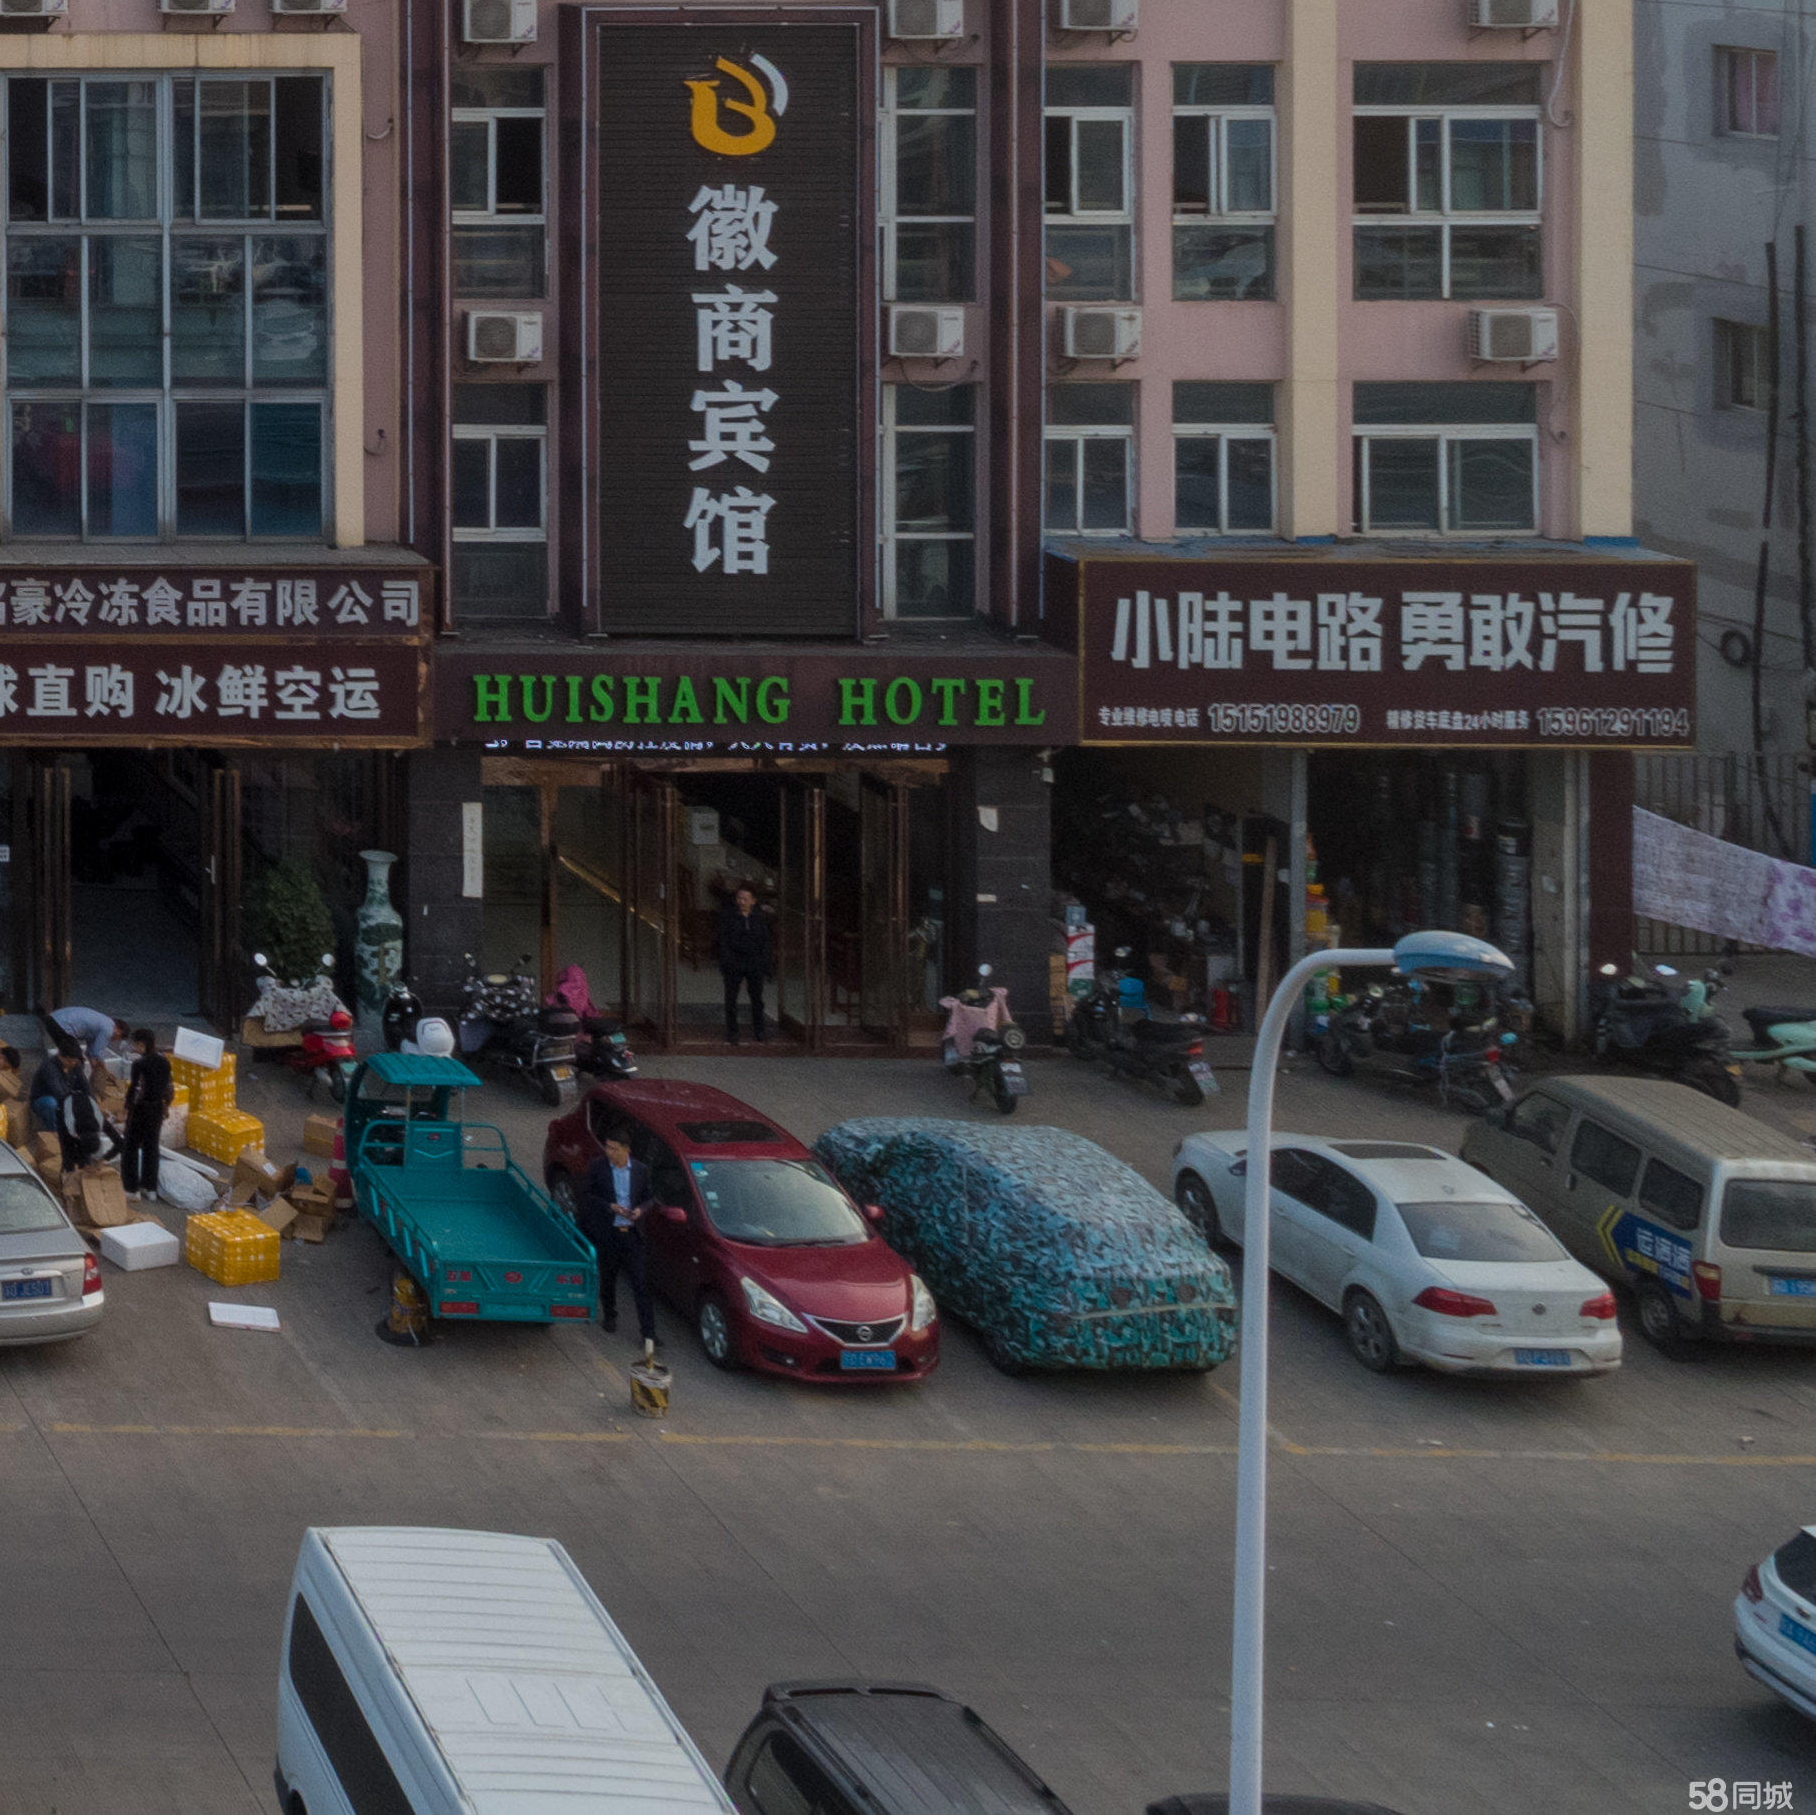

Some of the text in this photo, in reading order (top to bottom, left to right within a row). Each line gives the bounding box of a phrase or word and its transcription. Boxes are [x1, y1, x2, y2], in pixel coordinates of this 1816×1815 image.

[684, 185, 780, 575] 徽商宾馆
[1110, 589, 1675, 674] 小陆电路 勇敢汽修
[154, 663, 381, 722] 冰鲜空运
[473, 674, 1046, 728] HUISHANG HOTEL
